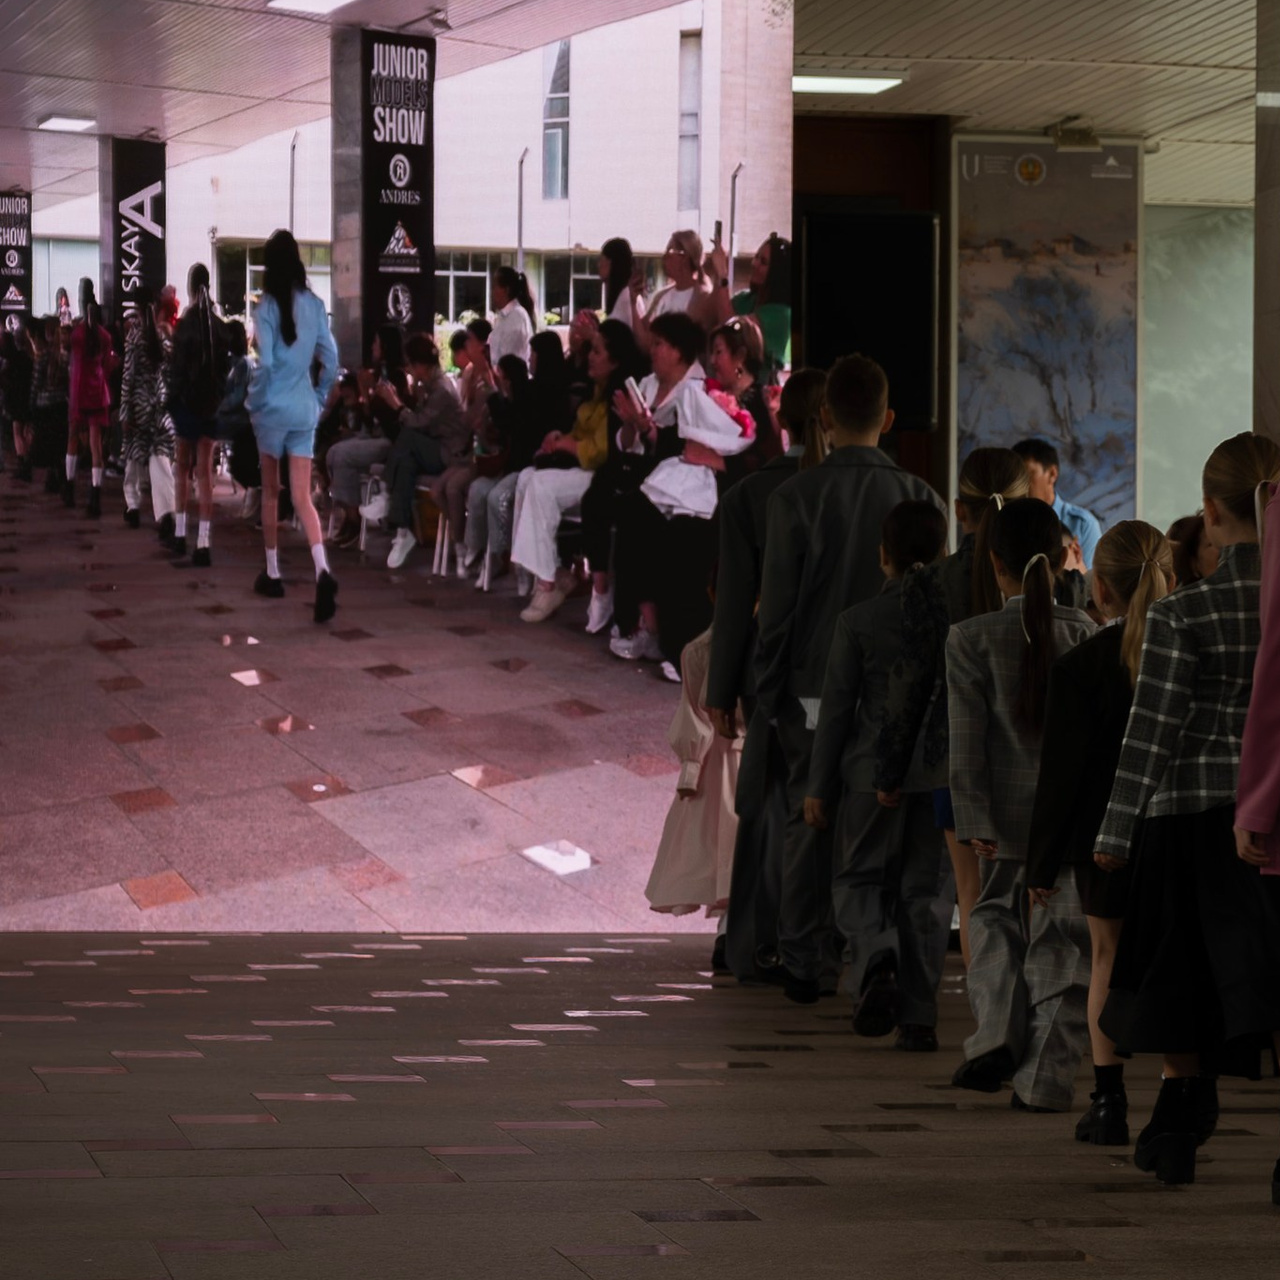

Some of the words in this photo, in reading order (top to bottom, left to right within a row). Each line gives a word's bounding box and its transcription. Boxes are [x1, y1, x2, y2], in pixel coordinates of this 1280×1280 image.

[371, 42, 428, 80] JUNIOR
[370, 74, 428, 111] MODELS
[373, 105, 426, 146] SHOW
[0, 196, 28, 215] UNIOR
[379, 189, 421, 205] ANDRES
